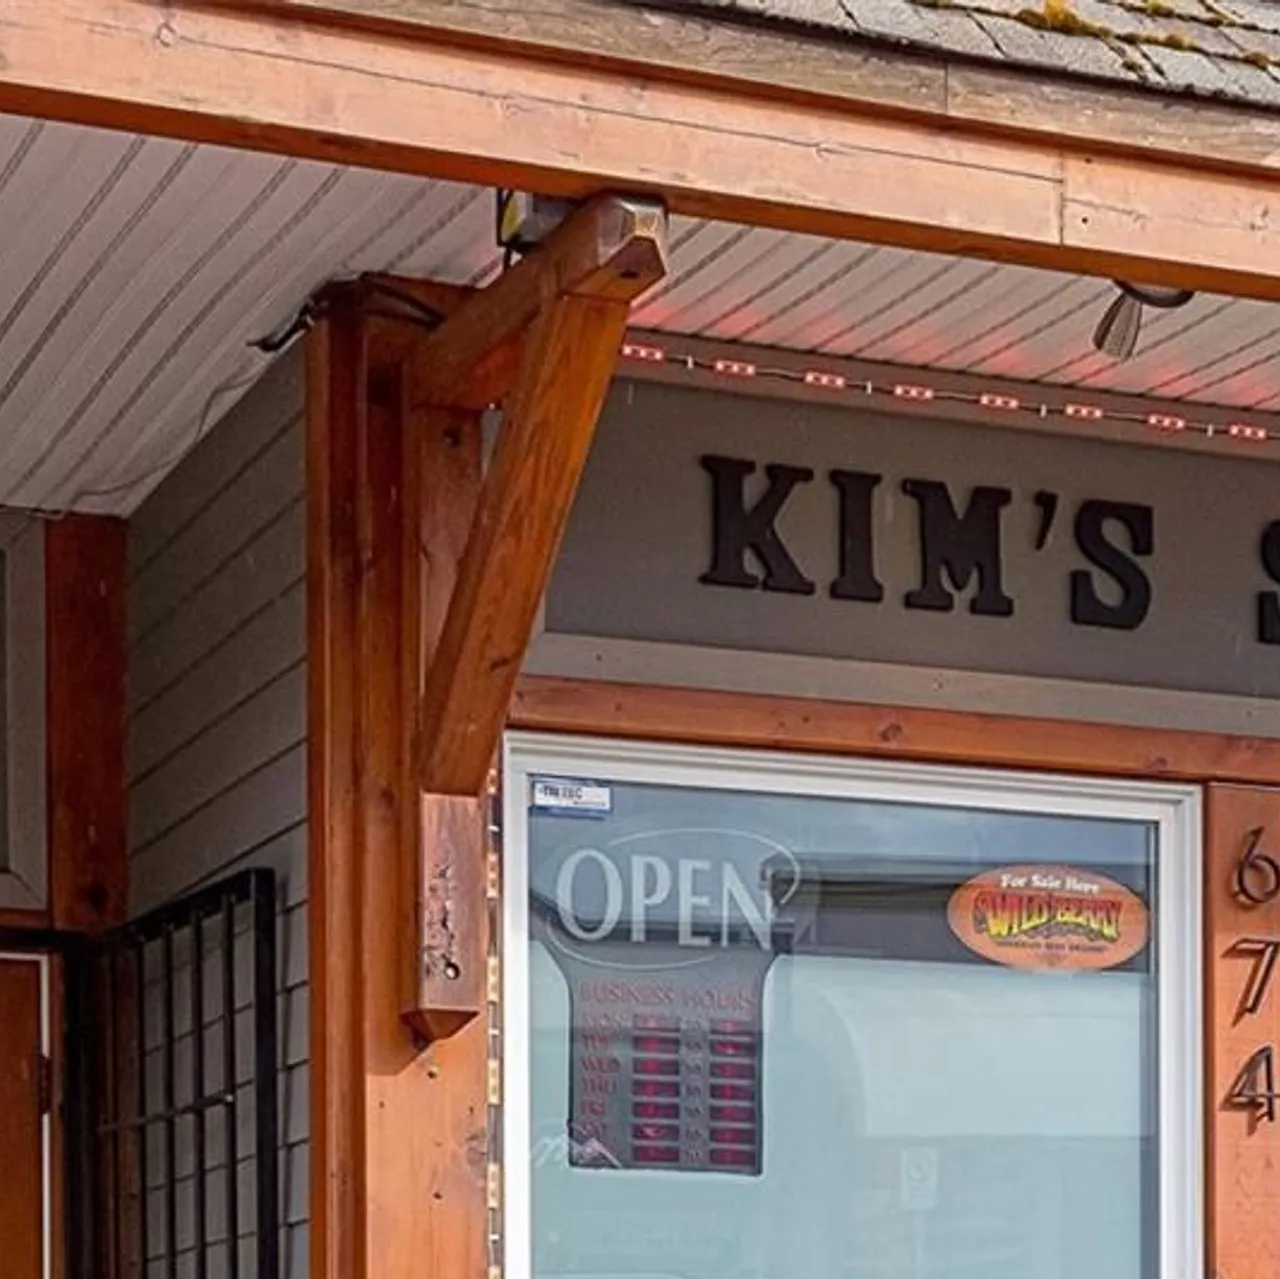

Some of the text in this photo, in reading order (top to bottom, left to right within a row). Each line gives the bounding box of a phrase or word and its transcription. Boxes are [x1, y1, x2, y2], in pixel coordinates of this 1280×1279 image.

[699, 454, 1155, 631] KIM'S
[556, 848, 777, 951] OPEN
[1000, 874, 1027, 889] For
[1066, 877, 1101, 894] Here
